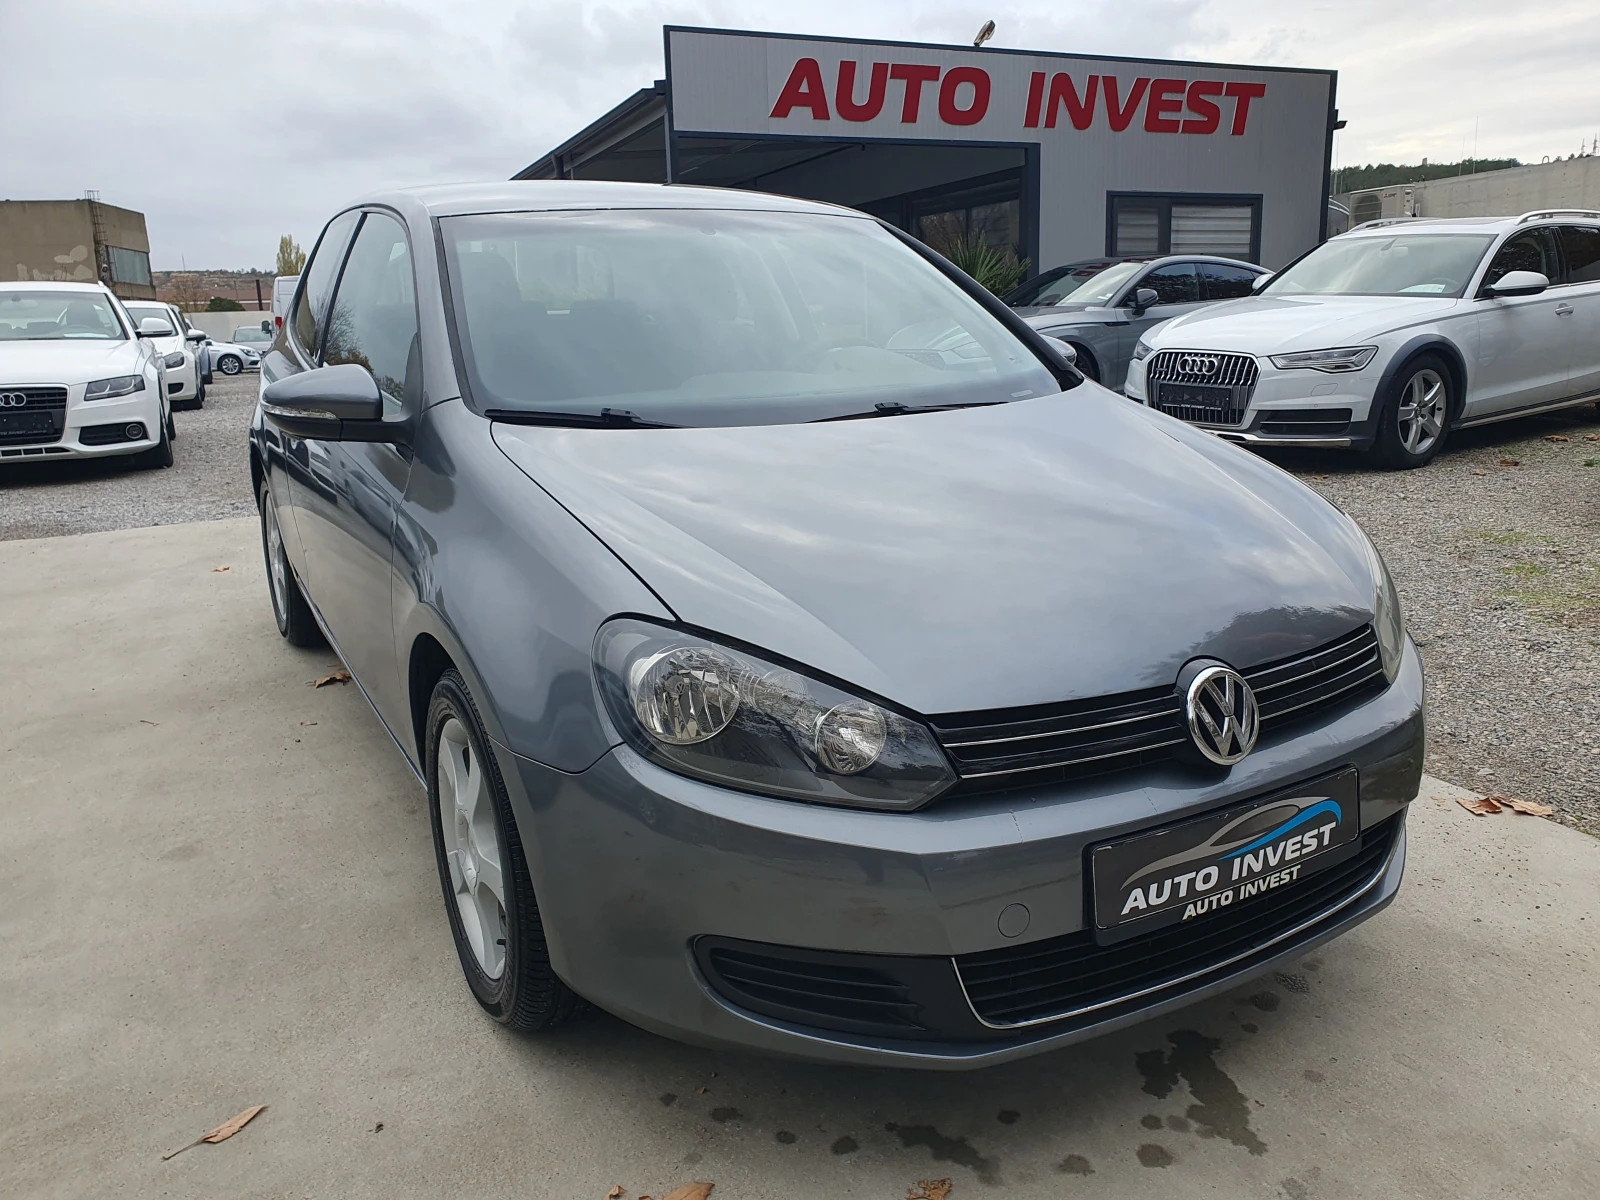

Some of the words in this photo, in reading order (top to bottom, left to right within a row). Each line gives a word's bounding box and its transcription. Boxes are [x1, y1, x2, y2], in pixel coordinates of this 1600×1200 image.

[770, 57, 991, 126] AUTO
[1023, 71, 1267, 136] INVEST
[1121, 865, 1219, 915] AUTO
[1231, 822, 1336, 881] INVEST
[1182, 890, 1233, 920] AUTO
[1239, 864, 1301, 899] INVEST
